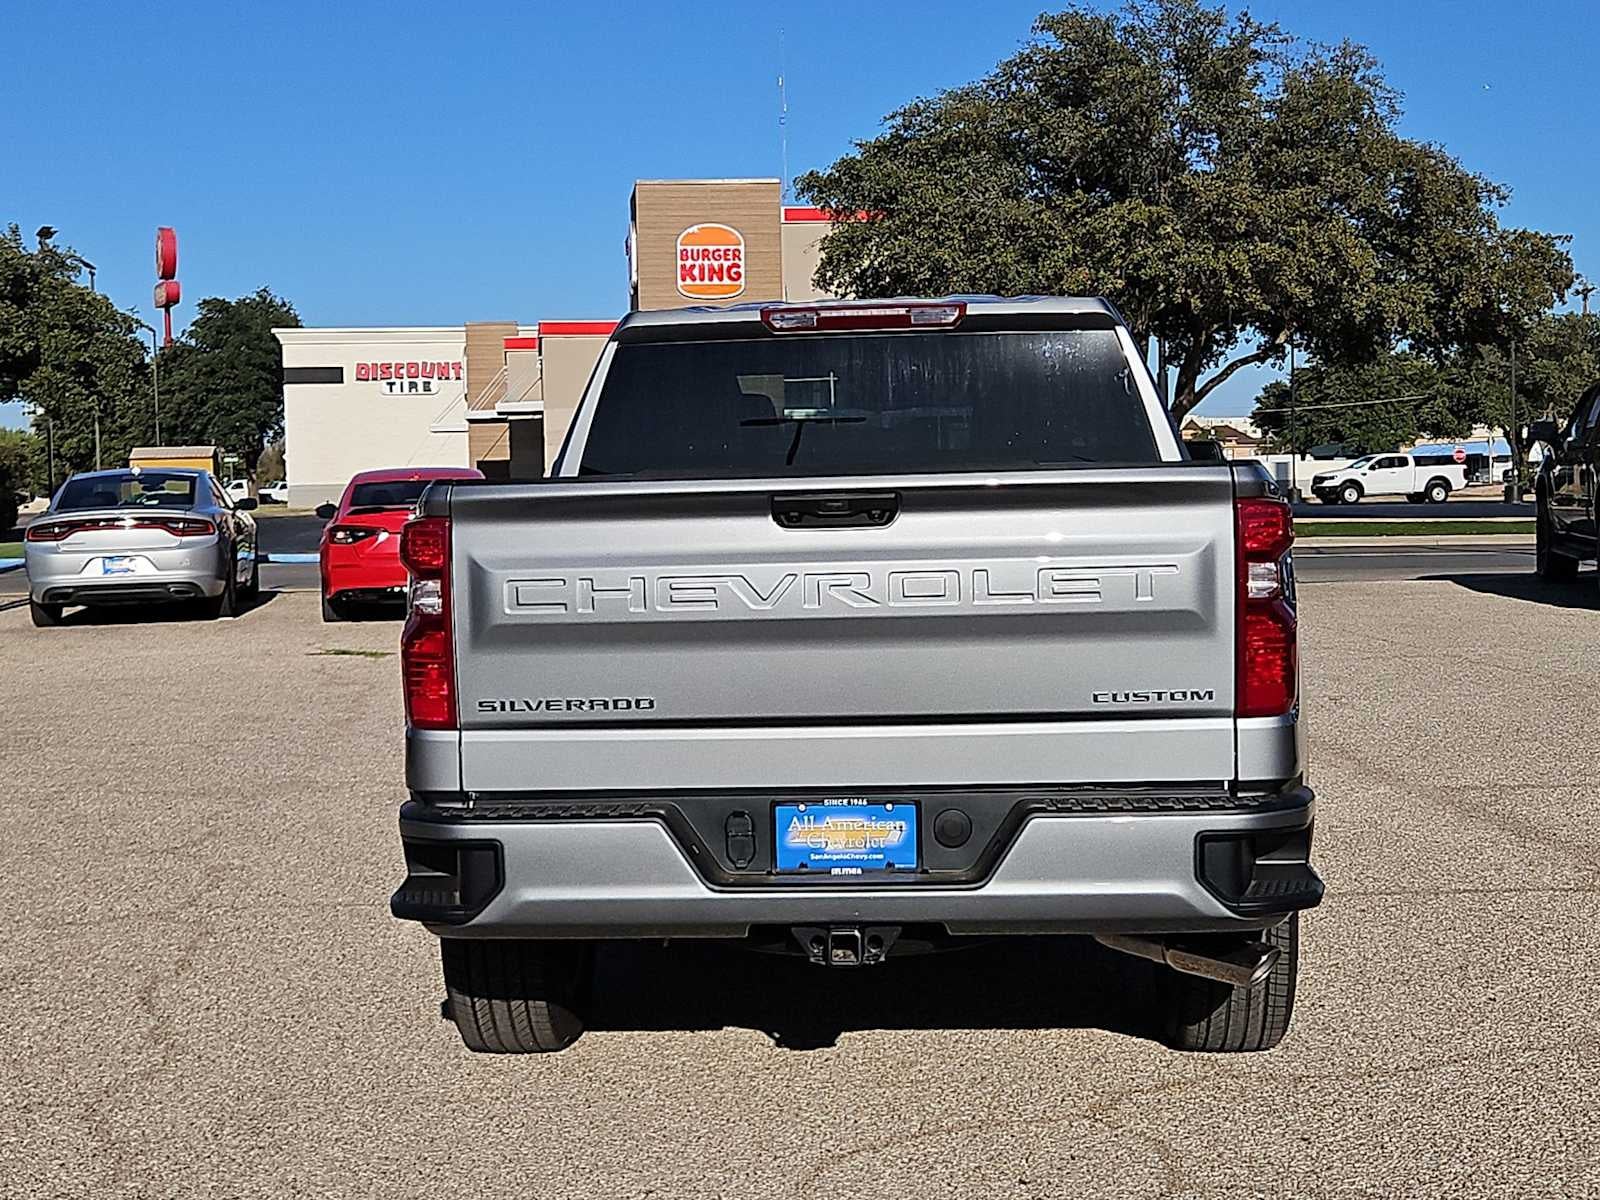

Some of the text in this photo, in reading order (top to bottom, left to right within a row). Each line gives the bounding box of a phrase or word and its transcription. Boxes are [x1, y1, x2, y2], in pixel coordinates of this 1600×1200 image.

[680, 248, 742, 261] BURGER
[680, 263, 742, 282] KING
[356, 361, 463, 381] DISCOUNT
[386, 381, 432, 393] TIRE
[503, 565, 1179, 614] CHEVROLET
[1092, 690, 1214, 703] CUSTOM
[478, 698, 656, 712] SILVERADO
[823, 798, 848, 806] SINCE
[788, 815, 906, 832] All American
[806, 832, 886, 849] Chevrolet
